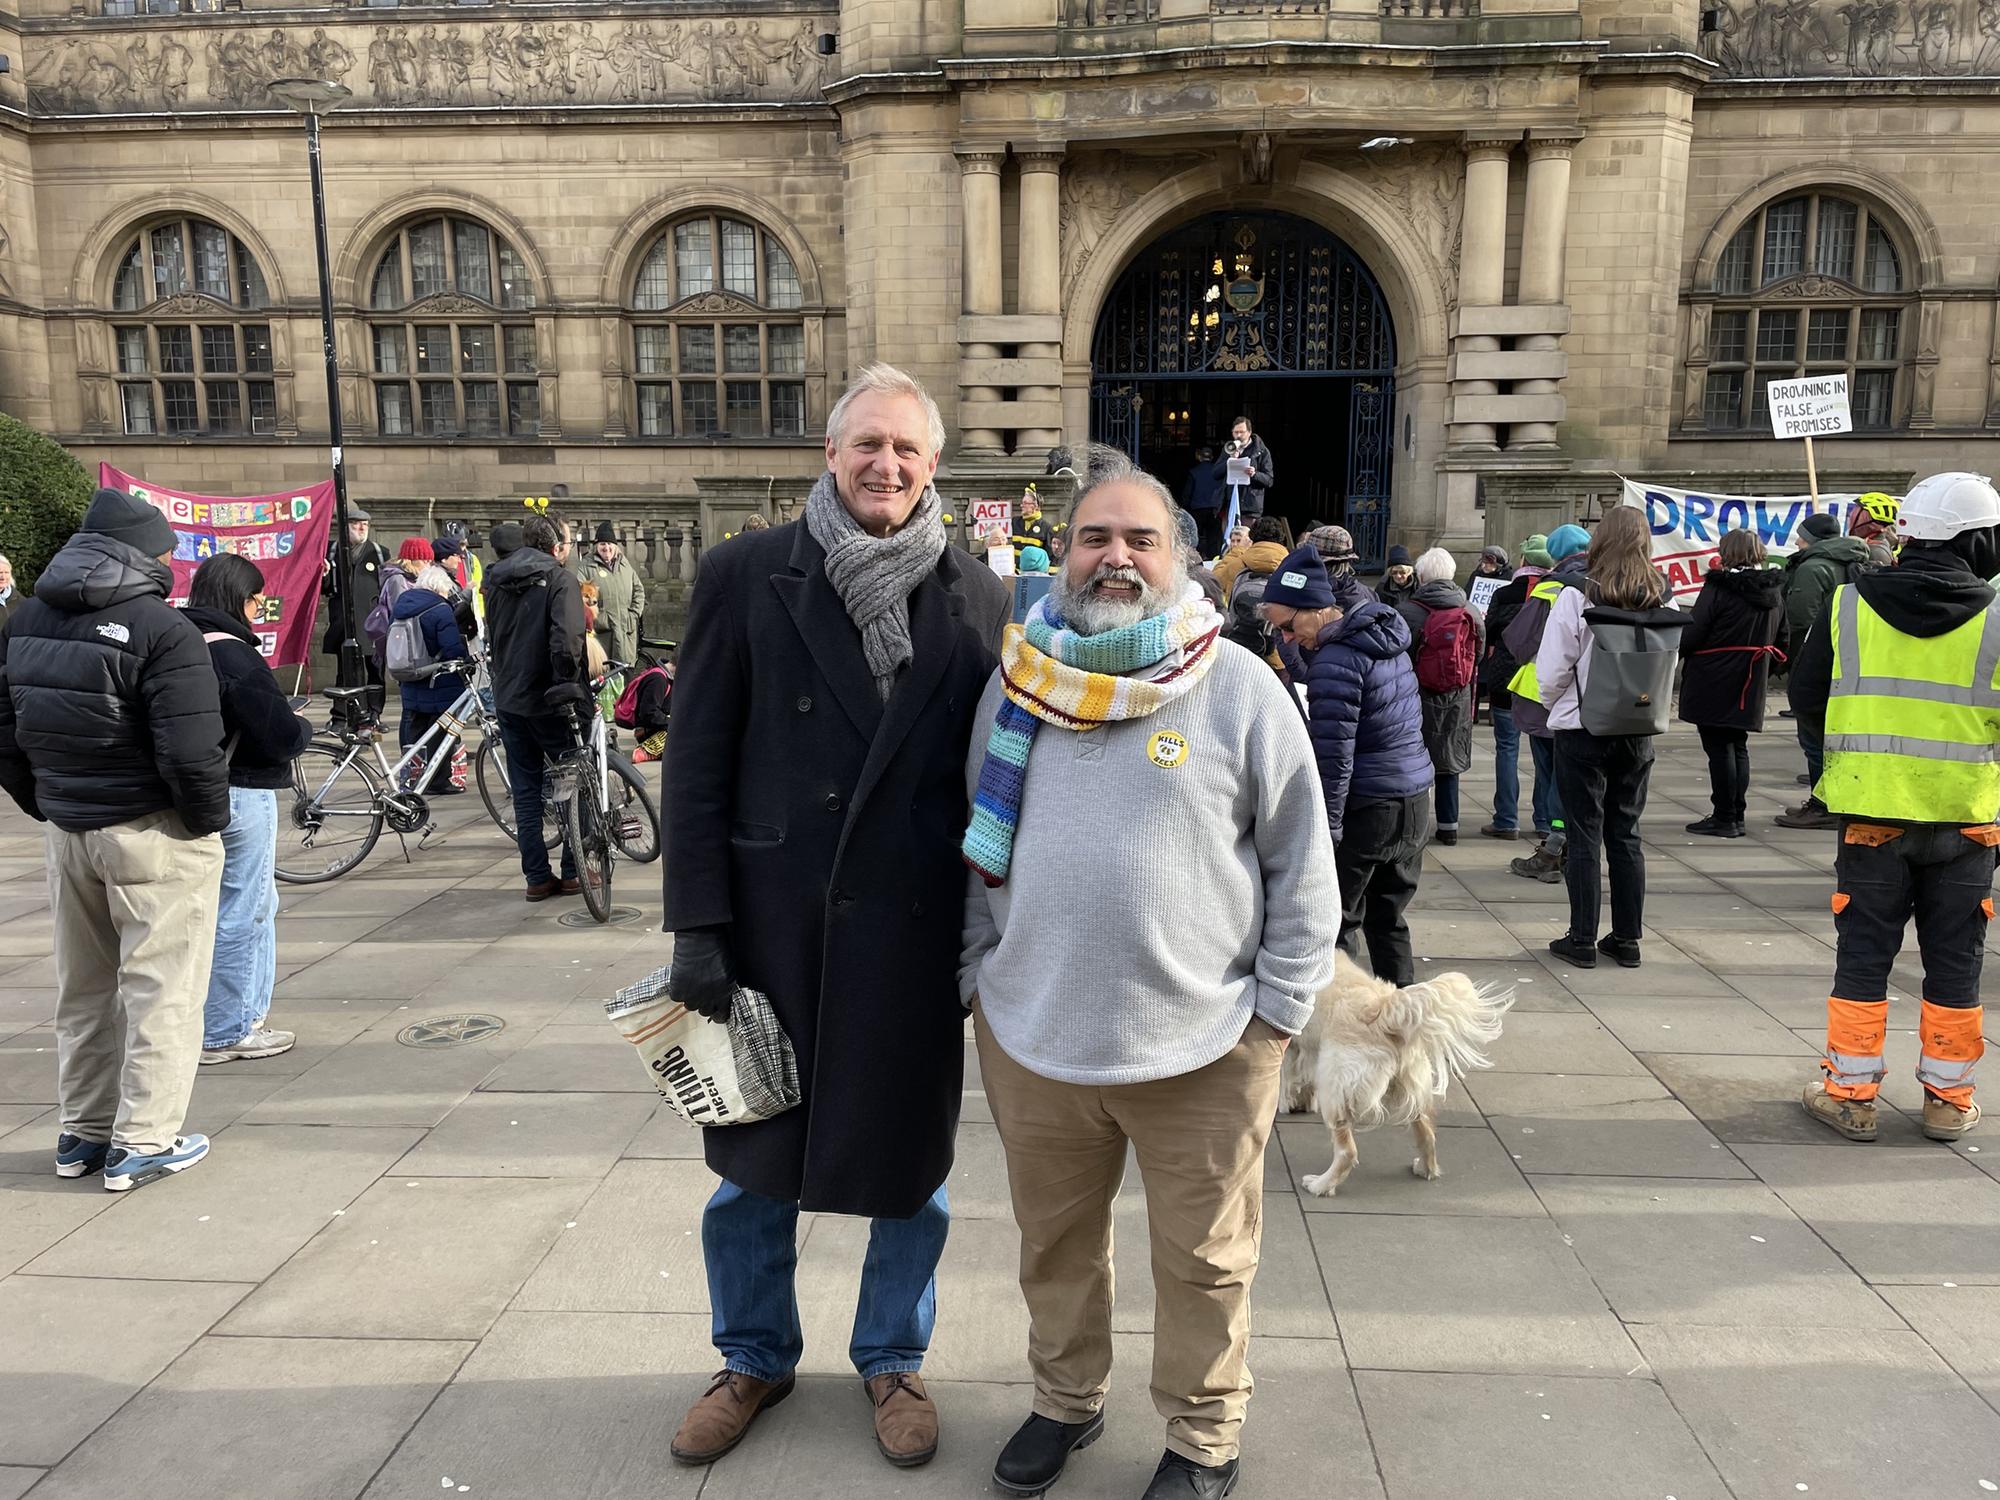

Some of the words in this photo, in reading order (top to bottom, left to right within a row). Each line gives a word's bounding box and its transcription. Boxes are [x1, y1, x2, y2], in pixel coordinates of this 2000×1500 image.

[1773, 382, 1831, 400] DROWNING
[1834, 380, 1846, 394] IN
[1777, 402, 1813, 418] FALSE
[1785, 417, 1841, 434] PROMISES
[976, 503, 1008, 518] ACT
[979, 521, 1009, 536] NW
[1158, 735, 1185, 748] KILLS
[701, 1075, 730, 1117] need
